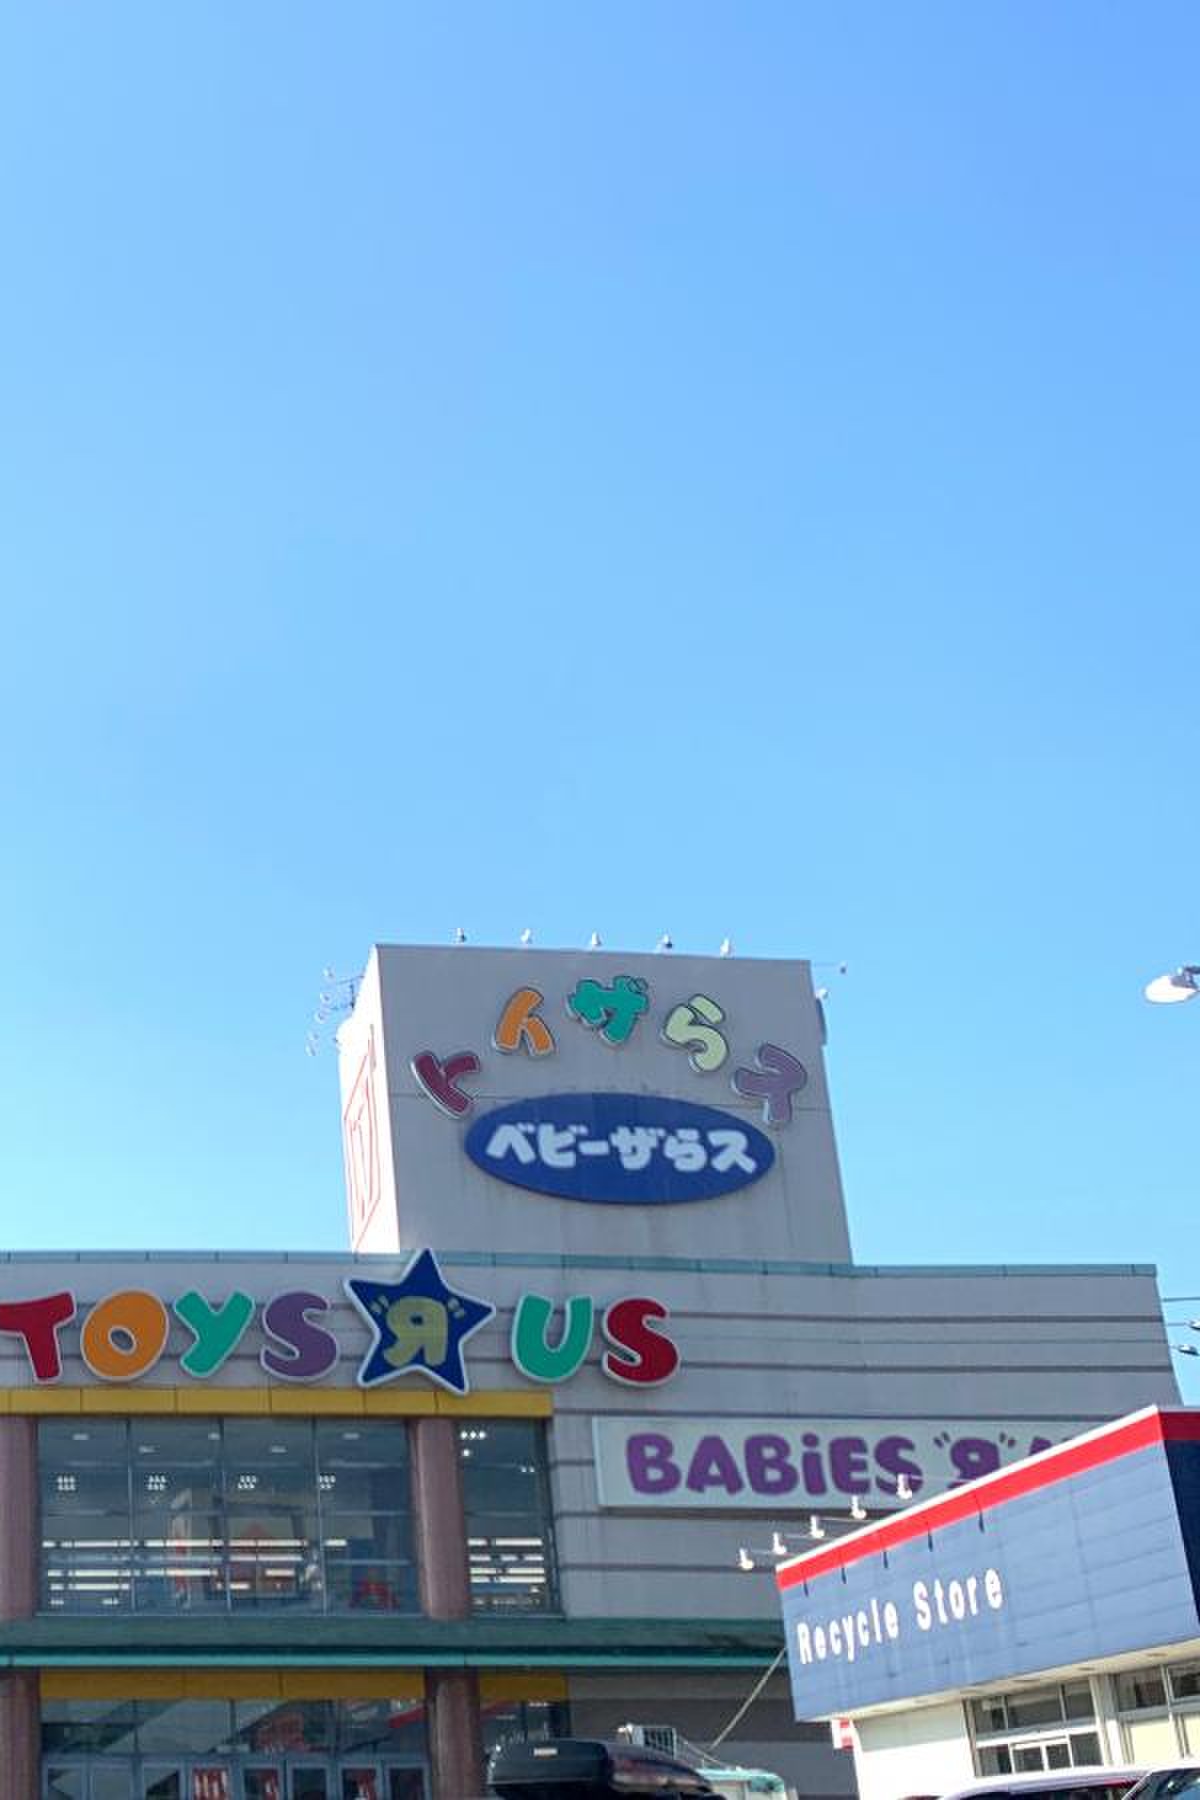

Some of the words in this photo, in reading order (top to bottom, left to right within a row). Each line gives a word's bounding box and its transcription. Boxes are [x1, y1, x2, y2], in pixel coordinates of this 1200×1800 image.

[486, 1122, 757, 1174] ベビーザらス
[511, 1293, 680, 1388] US
[796, 1595, 899, 1665] Recycle
[913, 1567, 1003, 1632] Store
